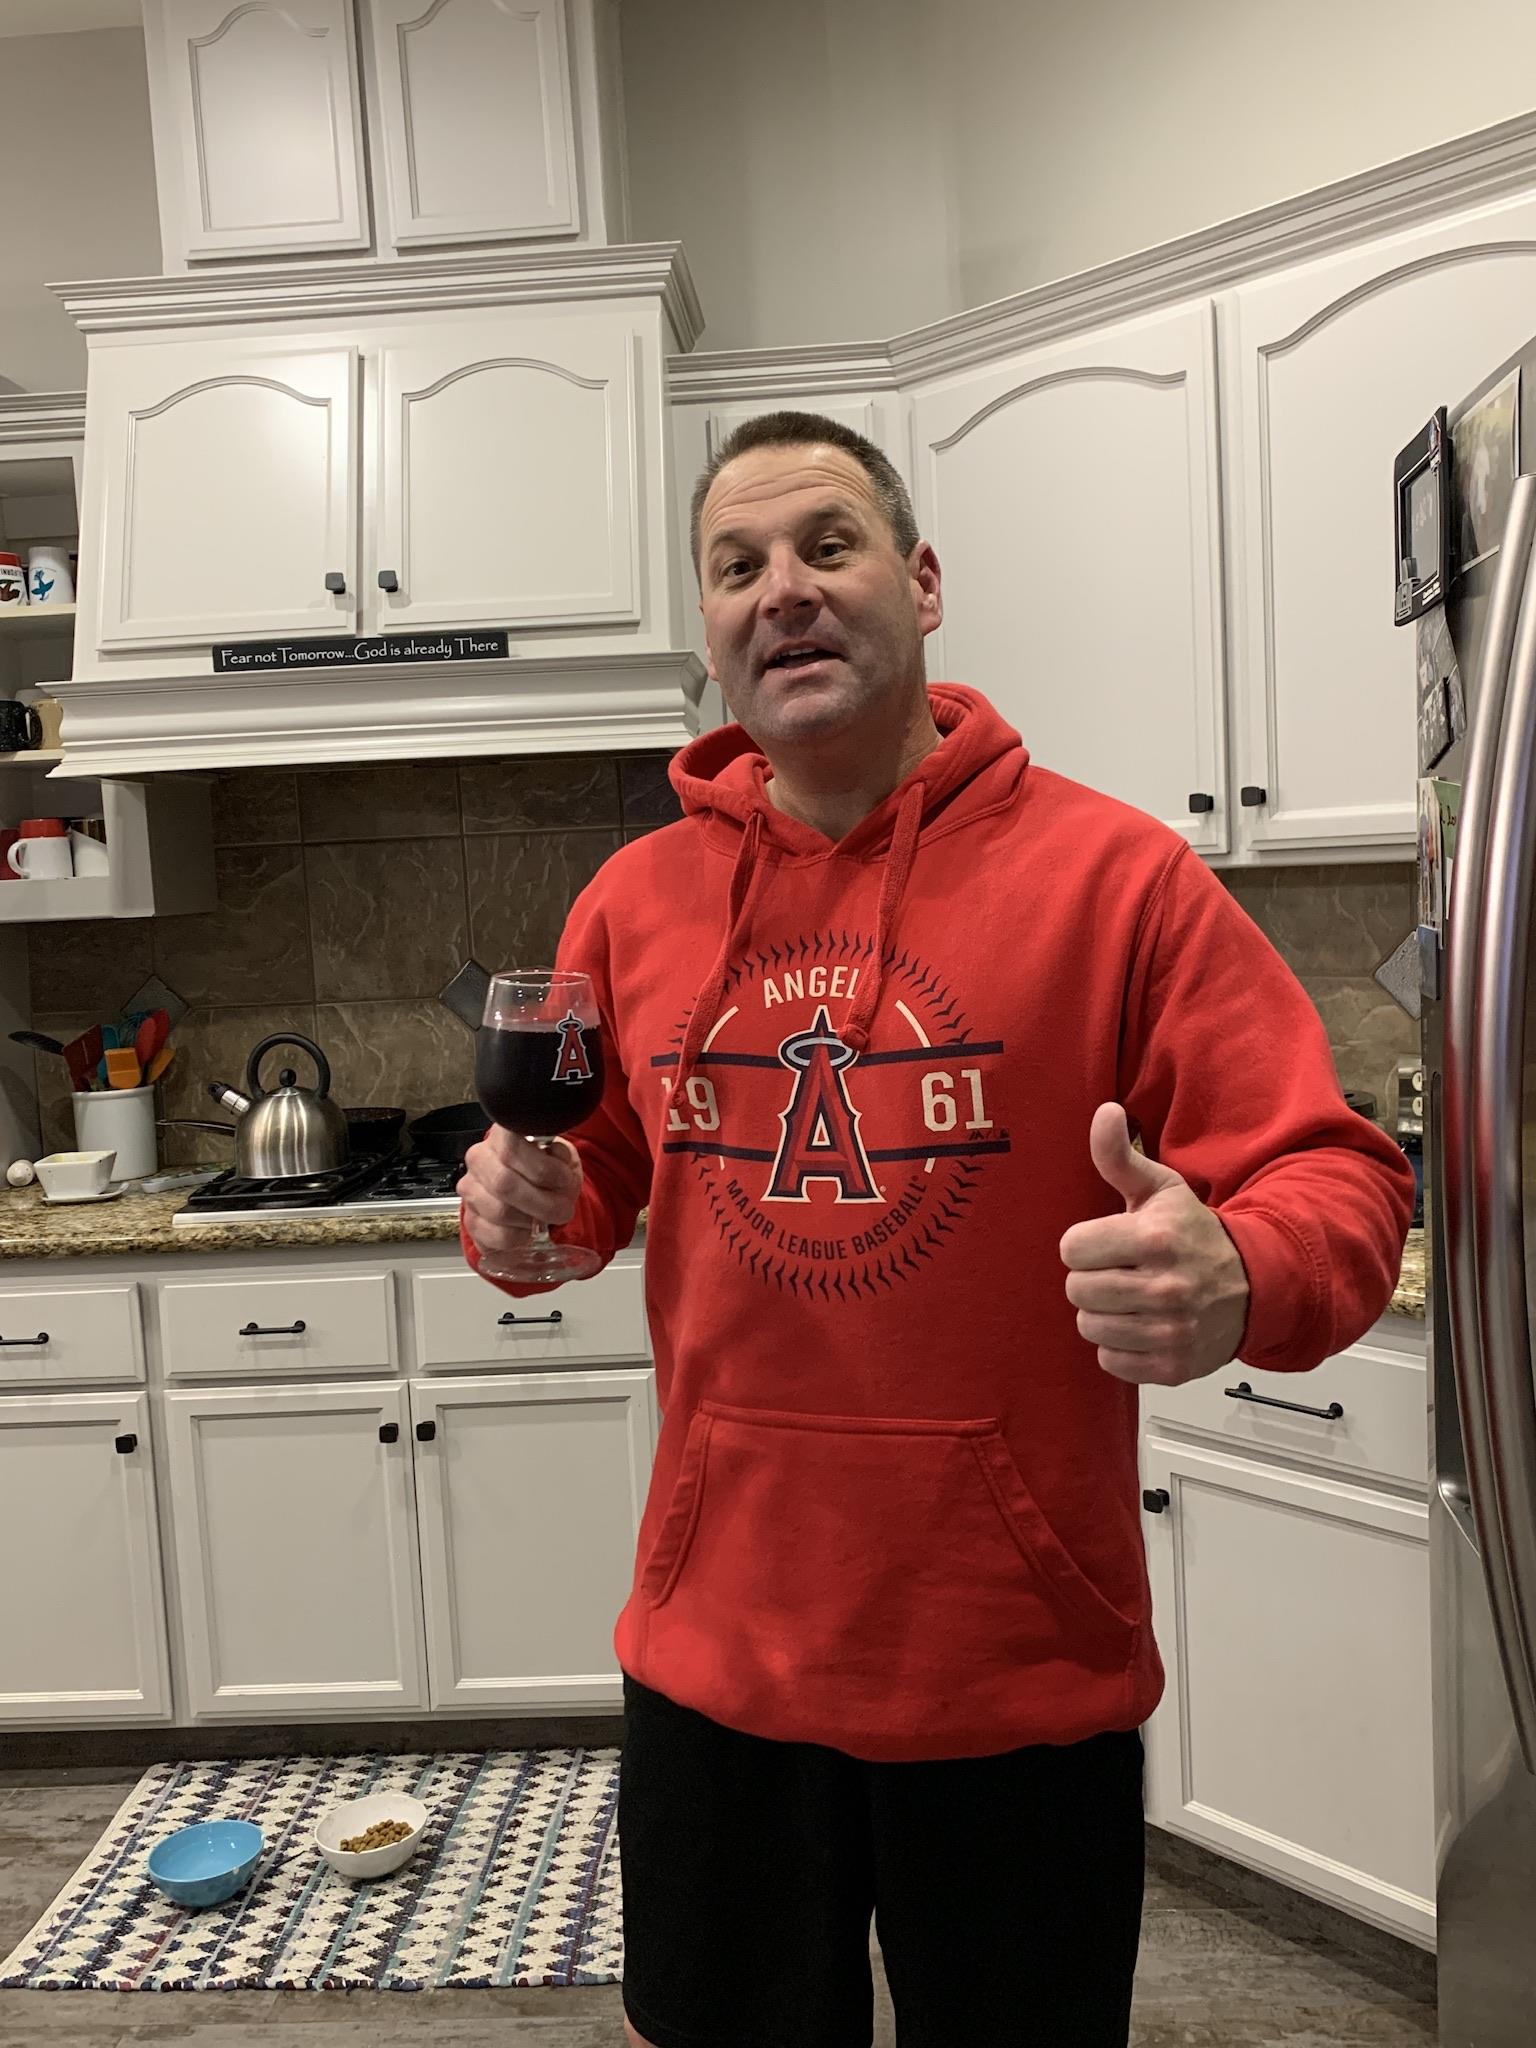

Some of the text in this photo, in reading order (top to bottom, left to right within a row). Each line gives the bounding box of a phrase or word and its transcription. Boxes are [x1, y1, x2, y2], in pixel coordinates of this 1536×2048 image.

[221, 649, 252, 667] Fear
[254, 651, 277, 663] not
[390, 643, 401, 656] is
[403, 638, 452, 659] already
[454, 636, 499, 655] There
[763, 966, 860, 1009] ANGEL
[661, 1068, 993, 1132] 19 61
[726, 1179, 927, 1261] MAJOR LEAGUE BASEBALL
